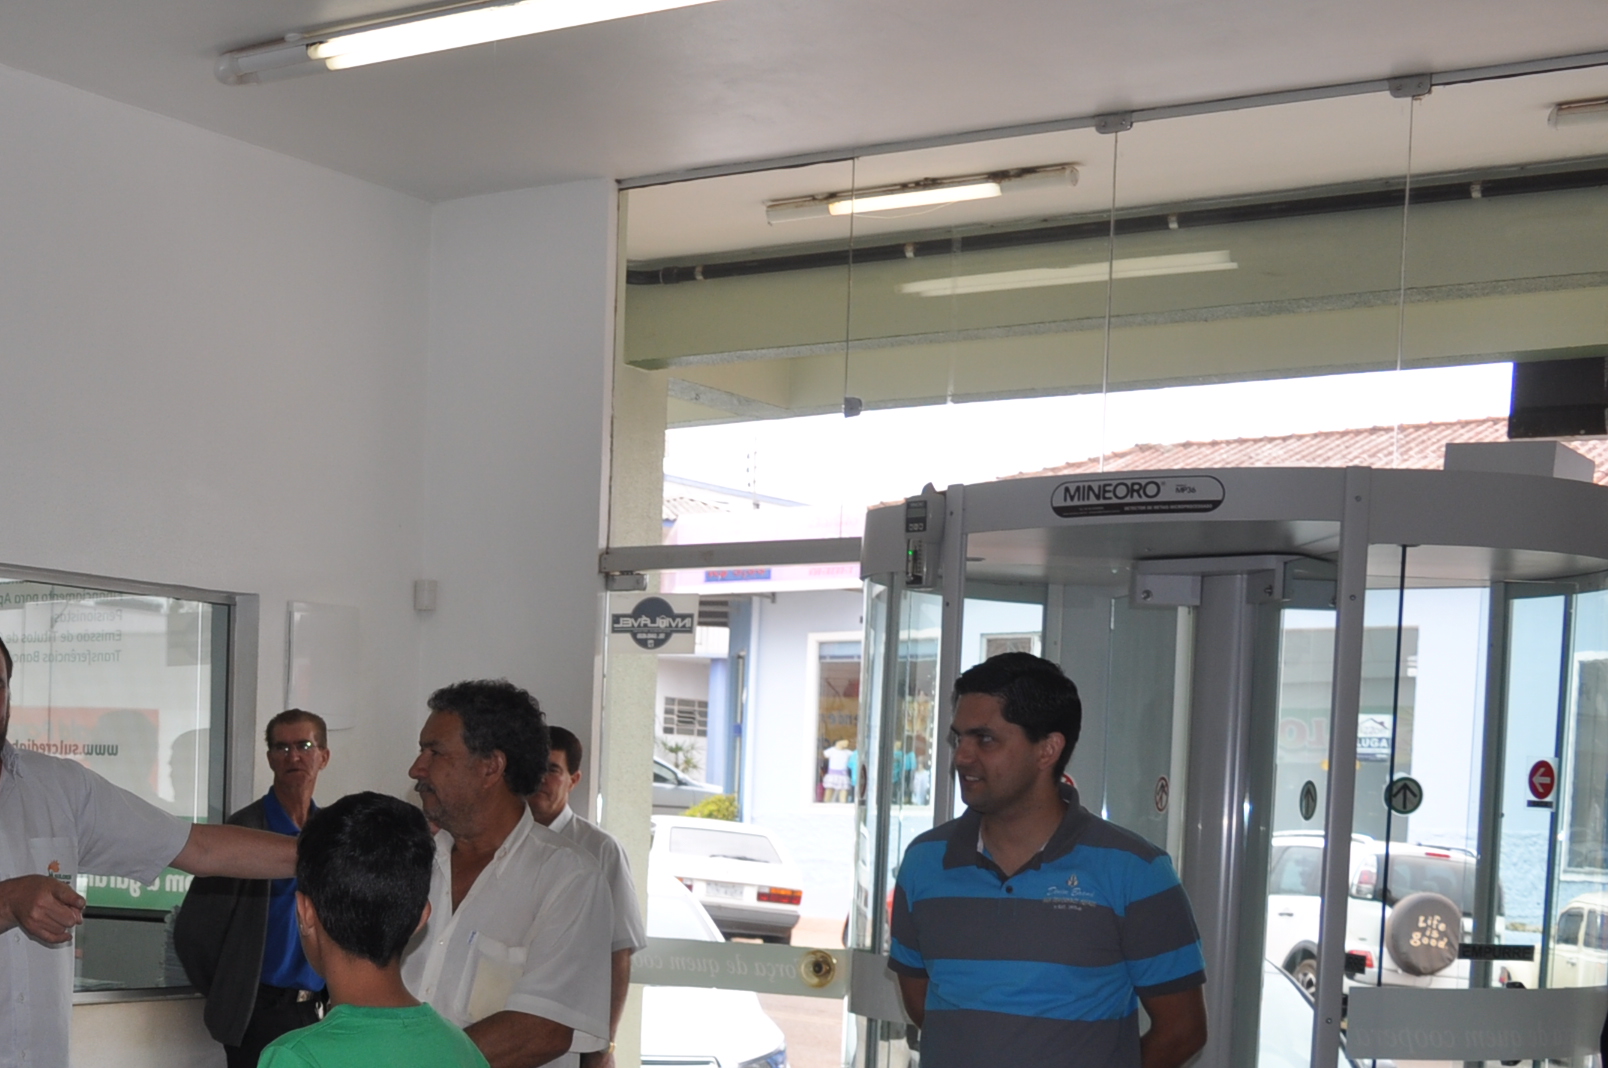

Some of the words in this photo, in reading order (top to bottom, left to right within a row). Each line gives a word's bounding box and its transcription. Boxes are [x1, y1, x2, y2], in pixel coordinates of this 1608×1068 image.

[1063, 481, 1161, 503] MINEORO
[1417, 914, 1447, 932] Life
[1425, 927, 1440, 938] is
[1462, 945, 1531, 959] EMPURRE
